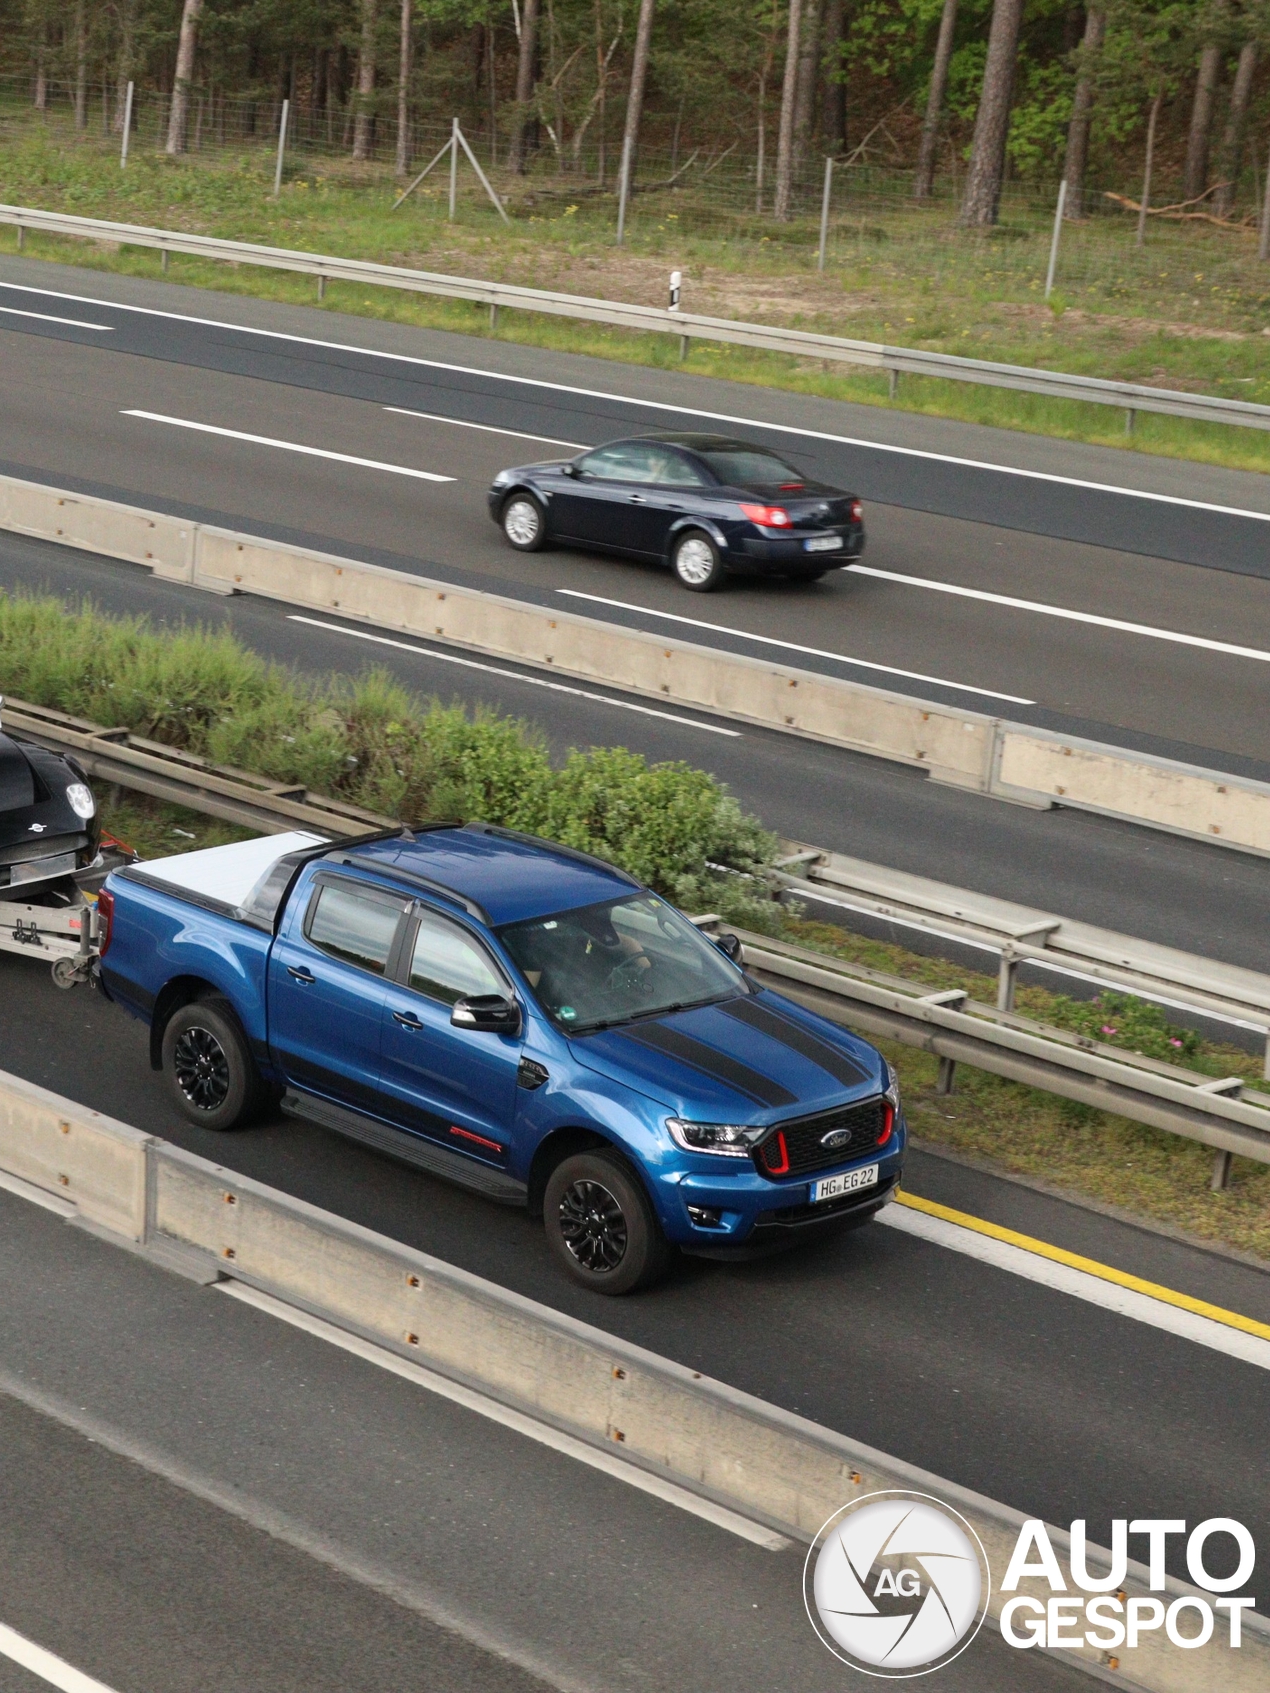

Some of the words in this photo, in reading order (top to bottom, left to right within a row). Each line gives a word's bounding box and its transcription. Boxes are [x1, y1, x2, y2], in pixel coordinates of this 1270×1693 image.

[821, 1179, 836, 1197] HG
[843, 1173, 858, 1190] EG
[859, 1168, 874, 1185] 22
